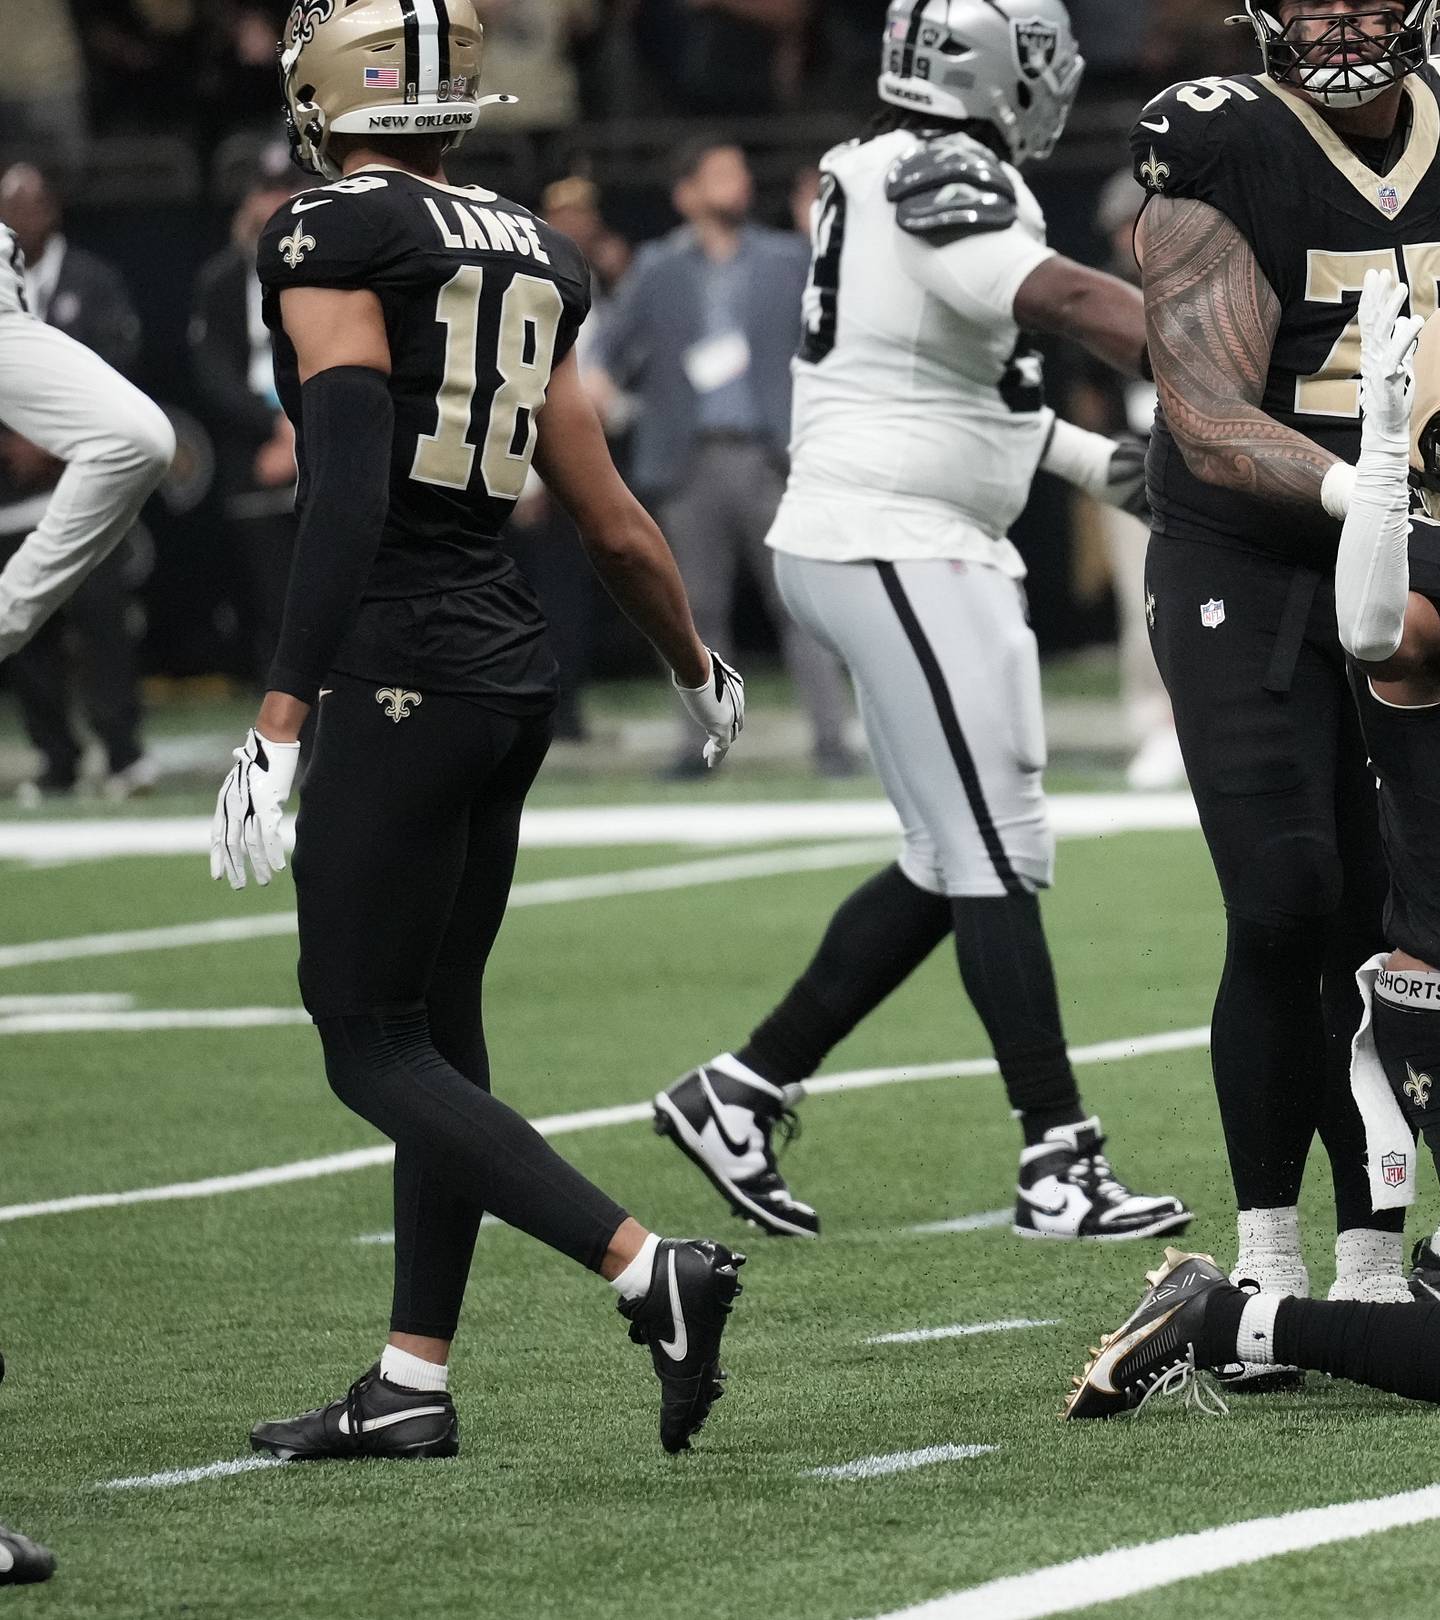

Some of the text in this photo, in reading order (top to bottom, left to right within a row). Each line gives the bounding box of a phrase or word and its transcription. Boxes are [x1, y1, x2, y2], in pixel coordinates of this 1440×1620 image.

[369, 113, 472, 128] NEW ORLEANS
[424, 198, 550, 265] LANCE
[409, 264, 564, 500] 18
